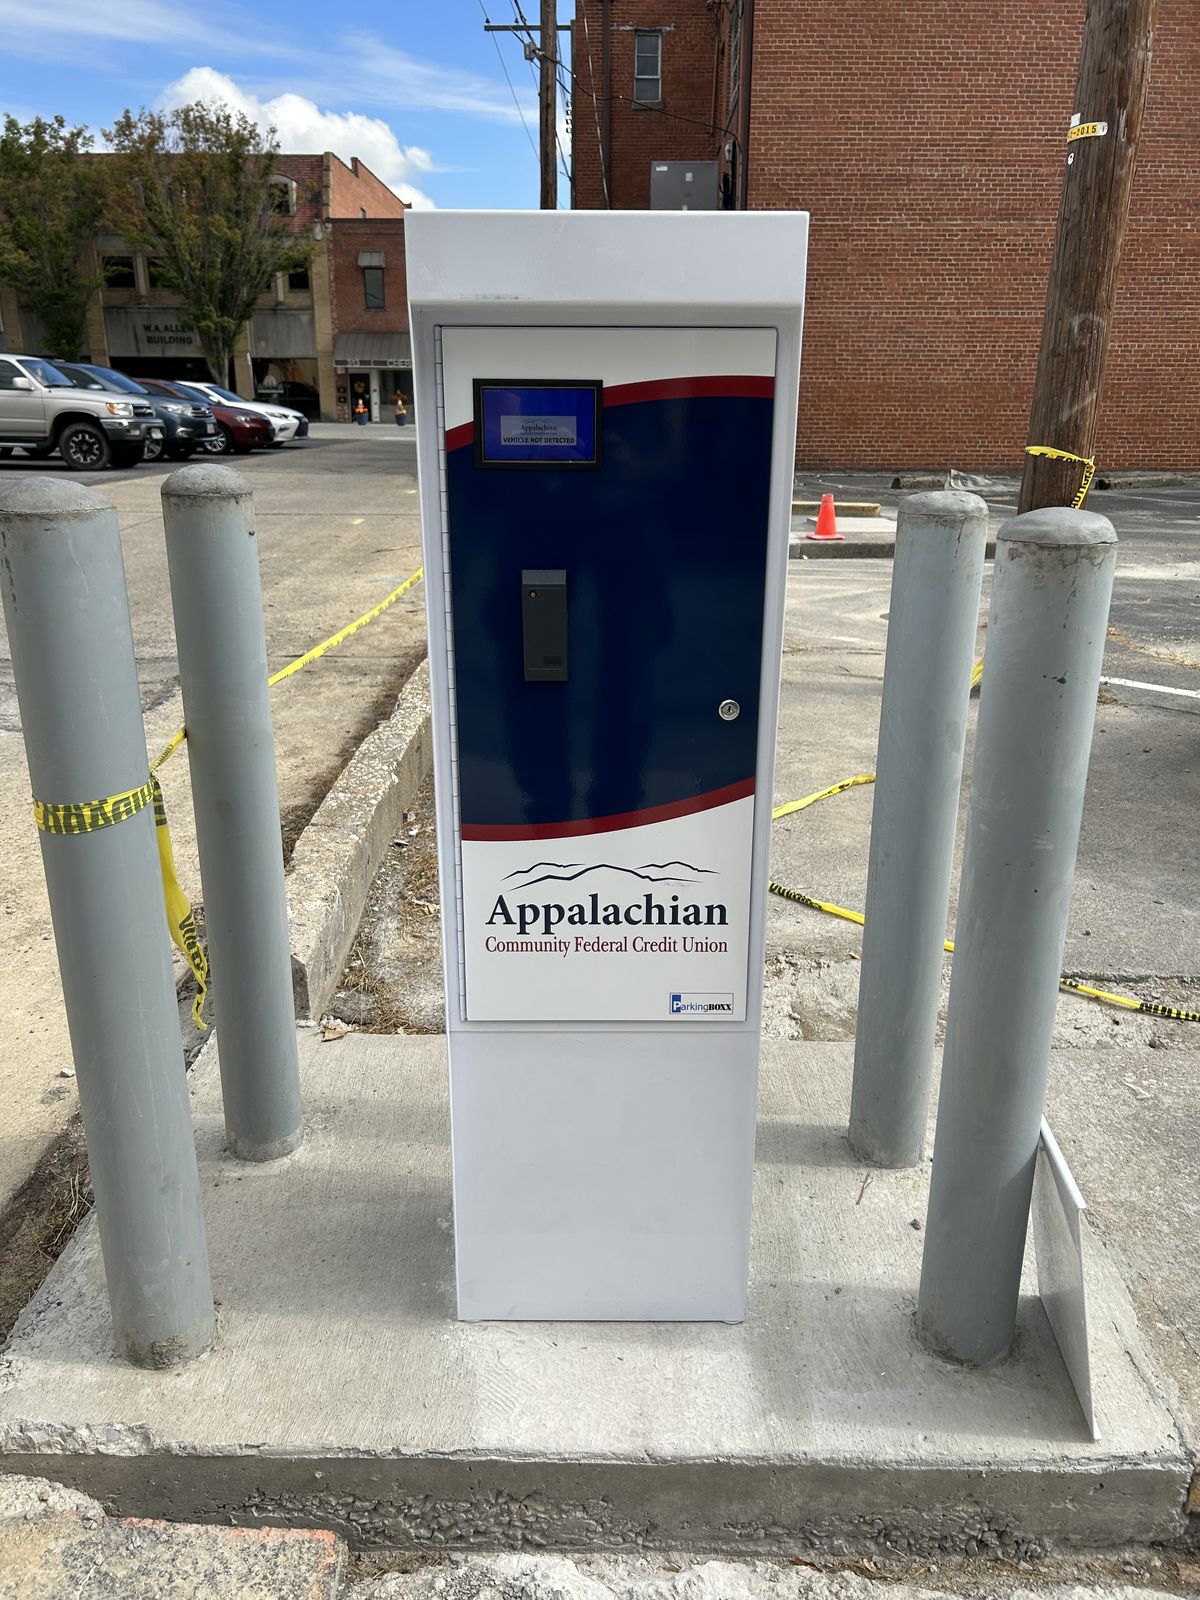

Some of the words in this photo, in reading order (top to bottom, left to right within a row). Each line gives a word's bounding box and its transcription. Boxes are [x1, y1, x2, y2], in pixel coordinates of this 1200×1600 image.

[146, 336, 193, 345] BUILDING
[485, 893, 729, 935] Appalachian
[485, 935, 570, 957] Community
[574, 936, 628, 953] Federal
[632, 936, 678, 953] Credit
[683, 936, 728, 953] Union
[673, 1001, 732, 1013] ParkingBOXX
